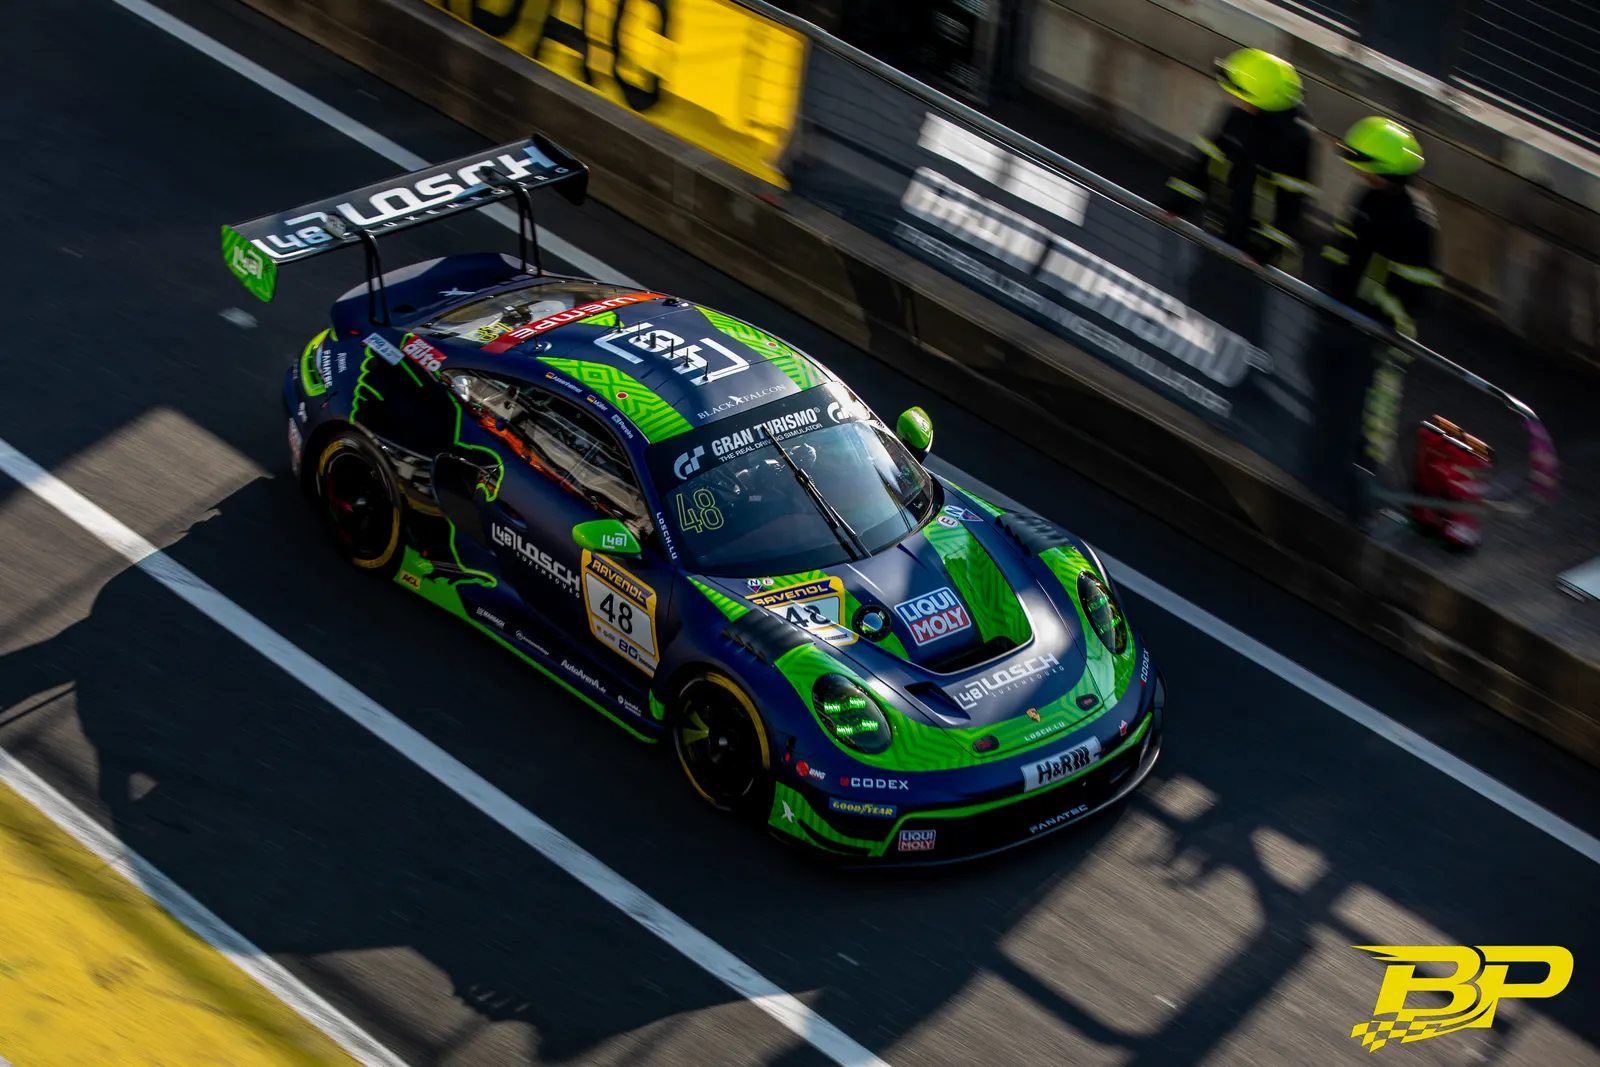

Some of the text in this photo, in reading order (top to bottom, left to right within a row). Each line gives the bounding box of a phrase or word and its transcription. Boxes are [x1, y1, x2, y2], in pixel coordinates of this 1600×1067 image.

[336, 145, 559, 227] LOSCH
[509, 296, 639, 339] WEMPE
[402, 343, 442, 372] auto
[697, 384, 786, 419] BLACK FALCON
[711, 427, 754, 457] GRAN
[719, 423, 823, 463] THE REAL DRIVNG SIMULATOR
[676, 488, 725, 534] 48
[656, 511, 678, 560] LOSCH.LU
[516, 551, 580, 598] LUXEMBOURG
[517, 535, 580, 591] LOSCH
[592, 559, 645, 603] RAVENOL
[752, 584, 829, 605] RAVENOL
[600, 592, 633, 634] 48
[785, 605, 831, 628] 48
[900, 590, 956, 622] LIQUI
[912, 606, 964, 641] MOLY
[980, 652, 1060, 690] LOSCH
[1141, 648, 1150, 682] CODEX
[1024, 721, 1065, 742] LOSCH.LU
[850, 777, 909, 791] CODEX
[902, 832, 934, 841] LIQUI
[1029, 804, 1088, 834] FANATEC
[901, 840, 933, 849] MOLY
